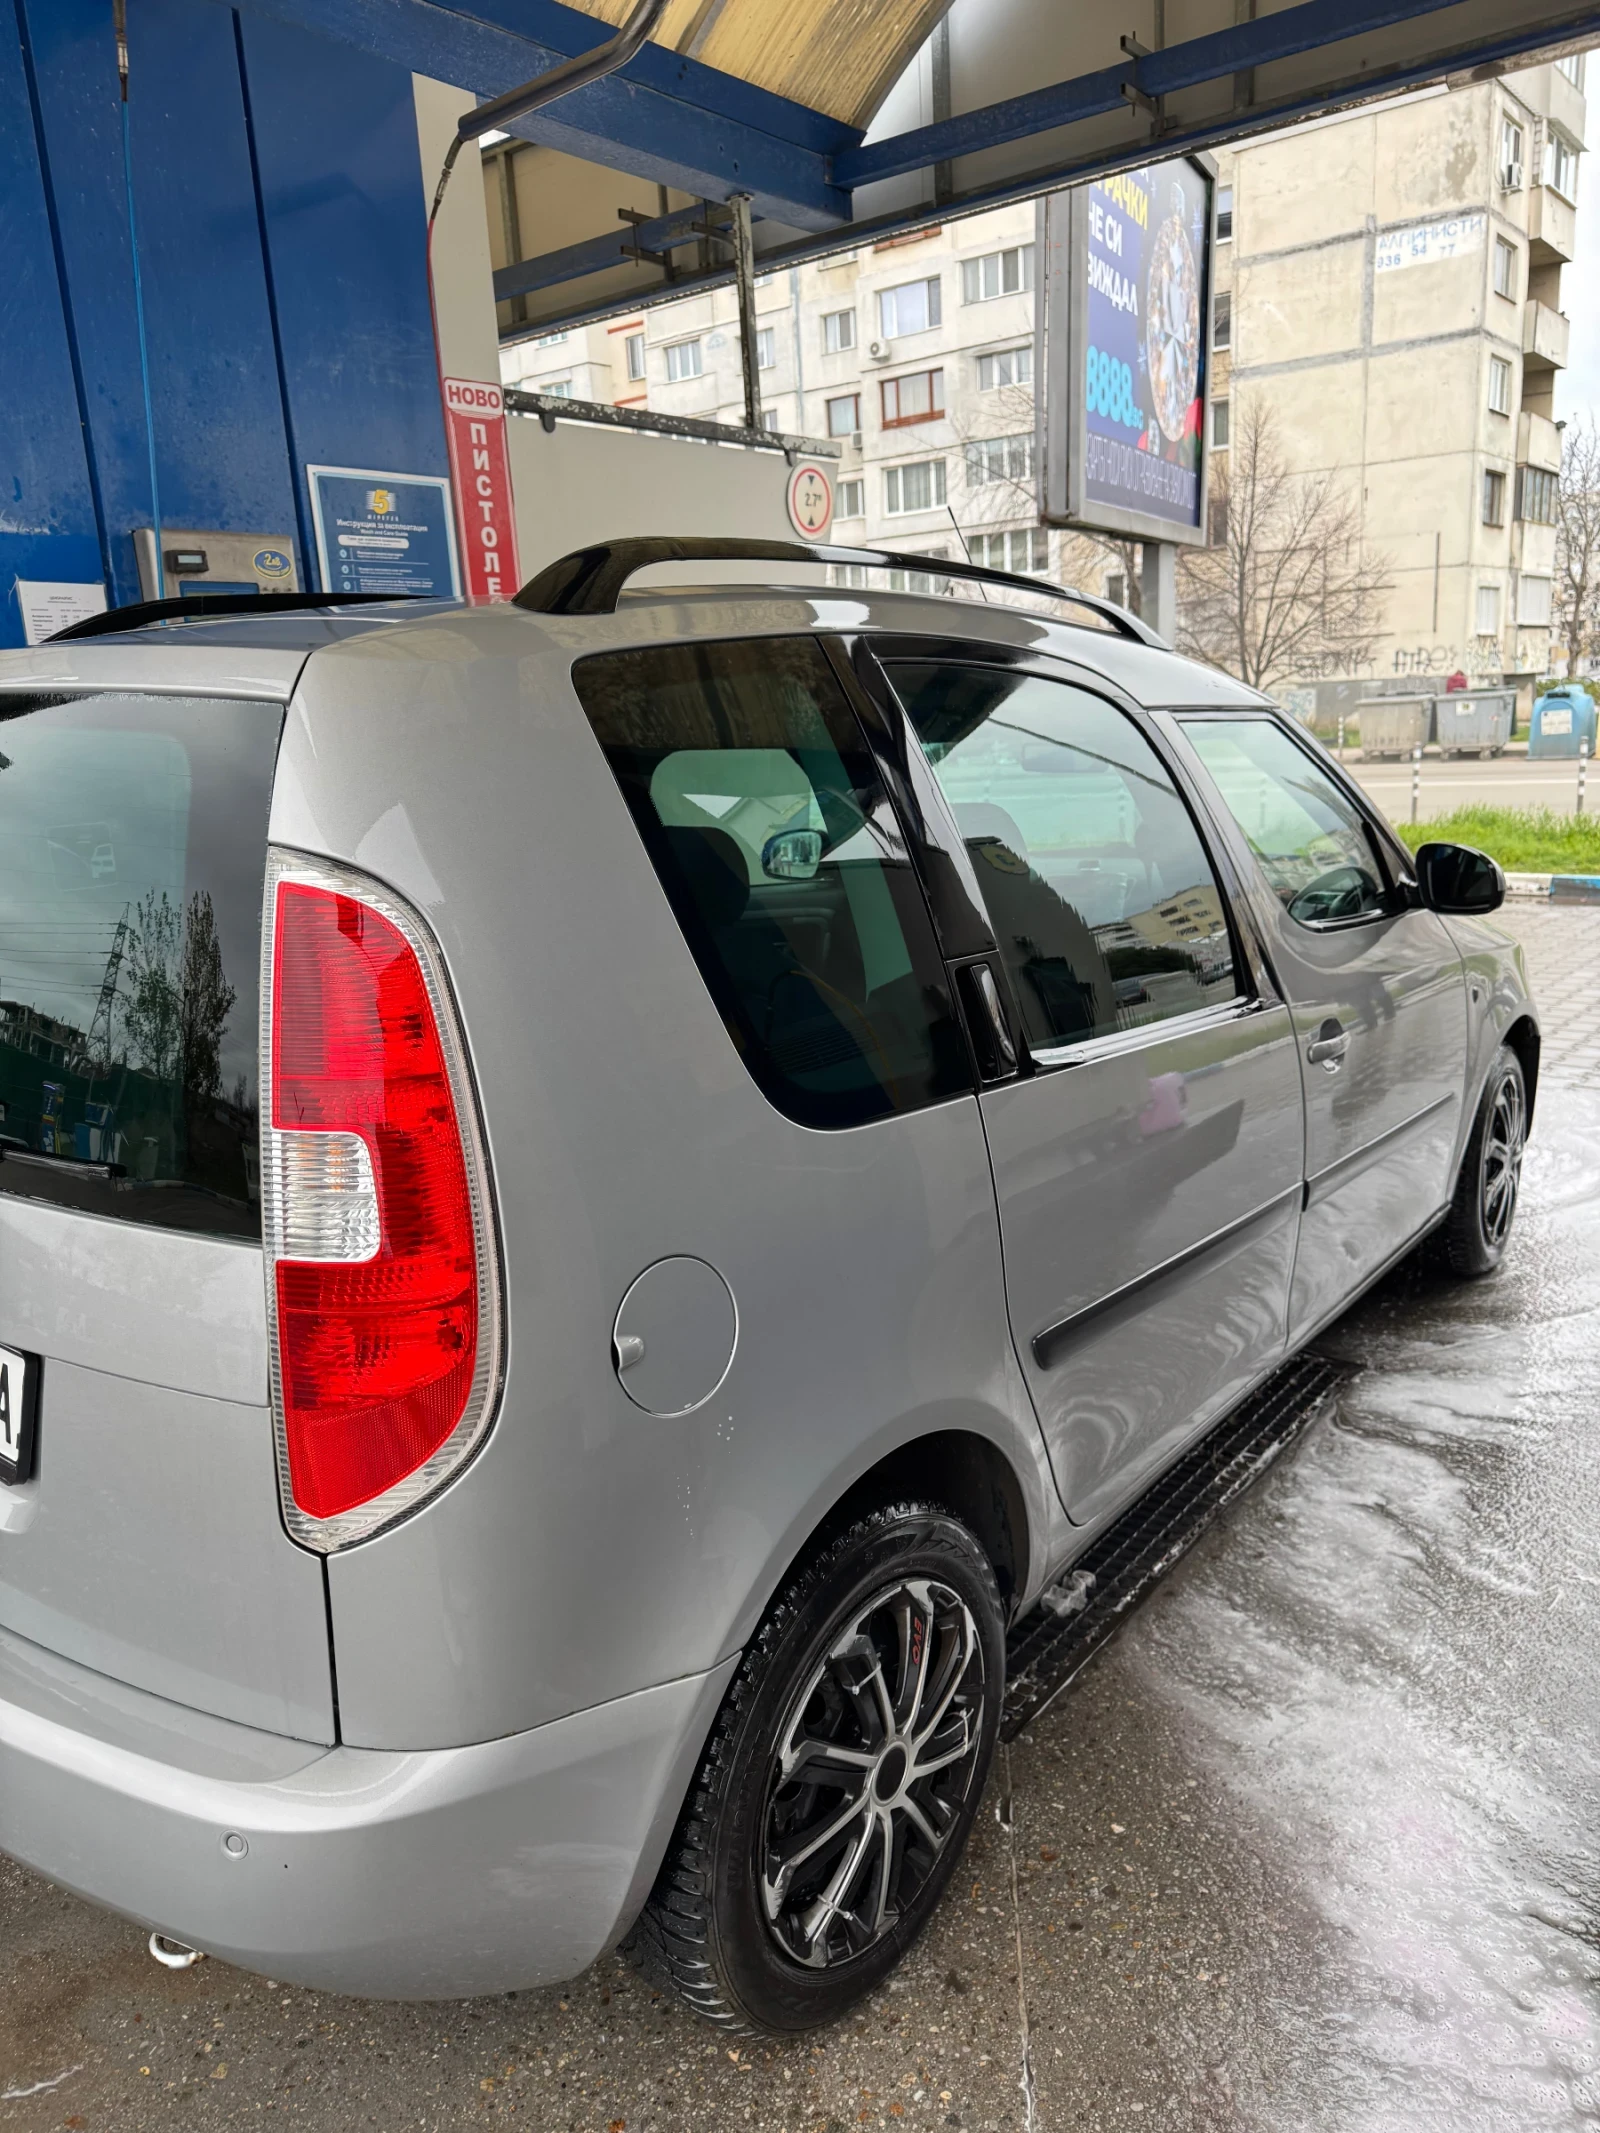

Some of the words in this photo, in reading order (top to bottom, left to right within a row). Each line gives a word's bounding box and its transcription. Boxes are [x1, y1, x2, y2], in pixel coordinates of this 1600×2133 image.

[1105, 215, 1122, 257] СИ
[447, 384, 500, 409] НОВО
[373, 489, 390, 515] 5
[912, 1616, 922, 1665] EVO
